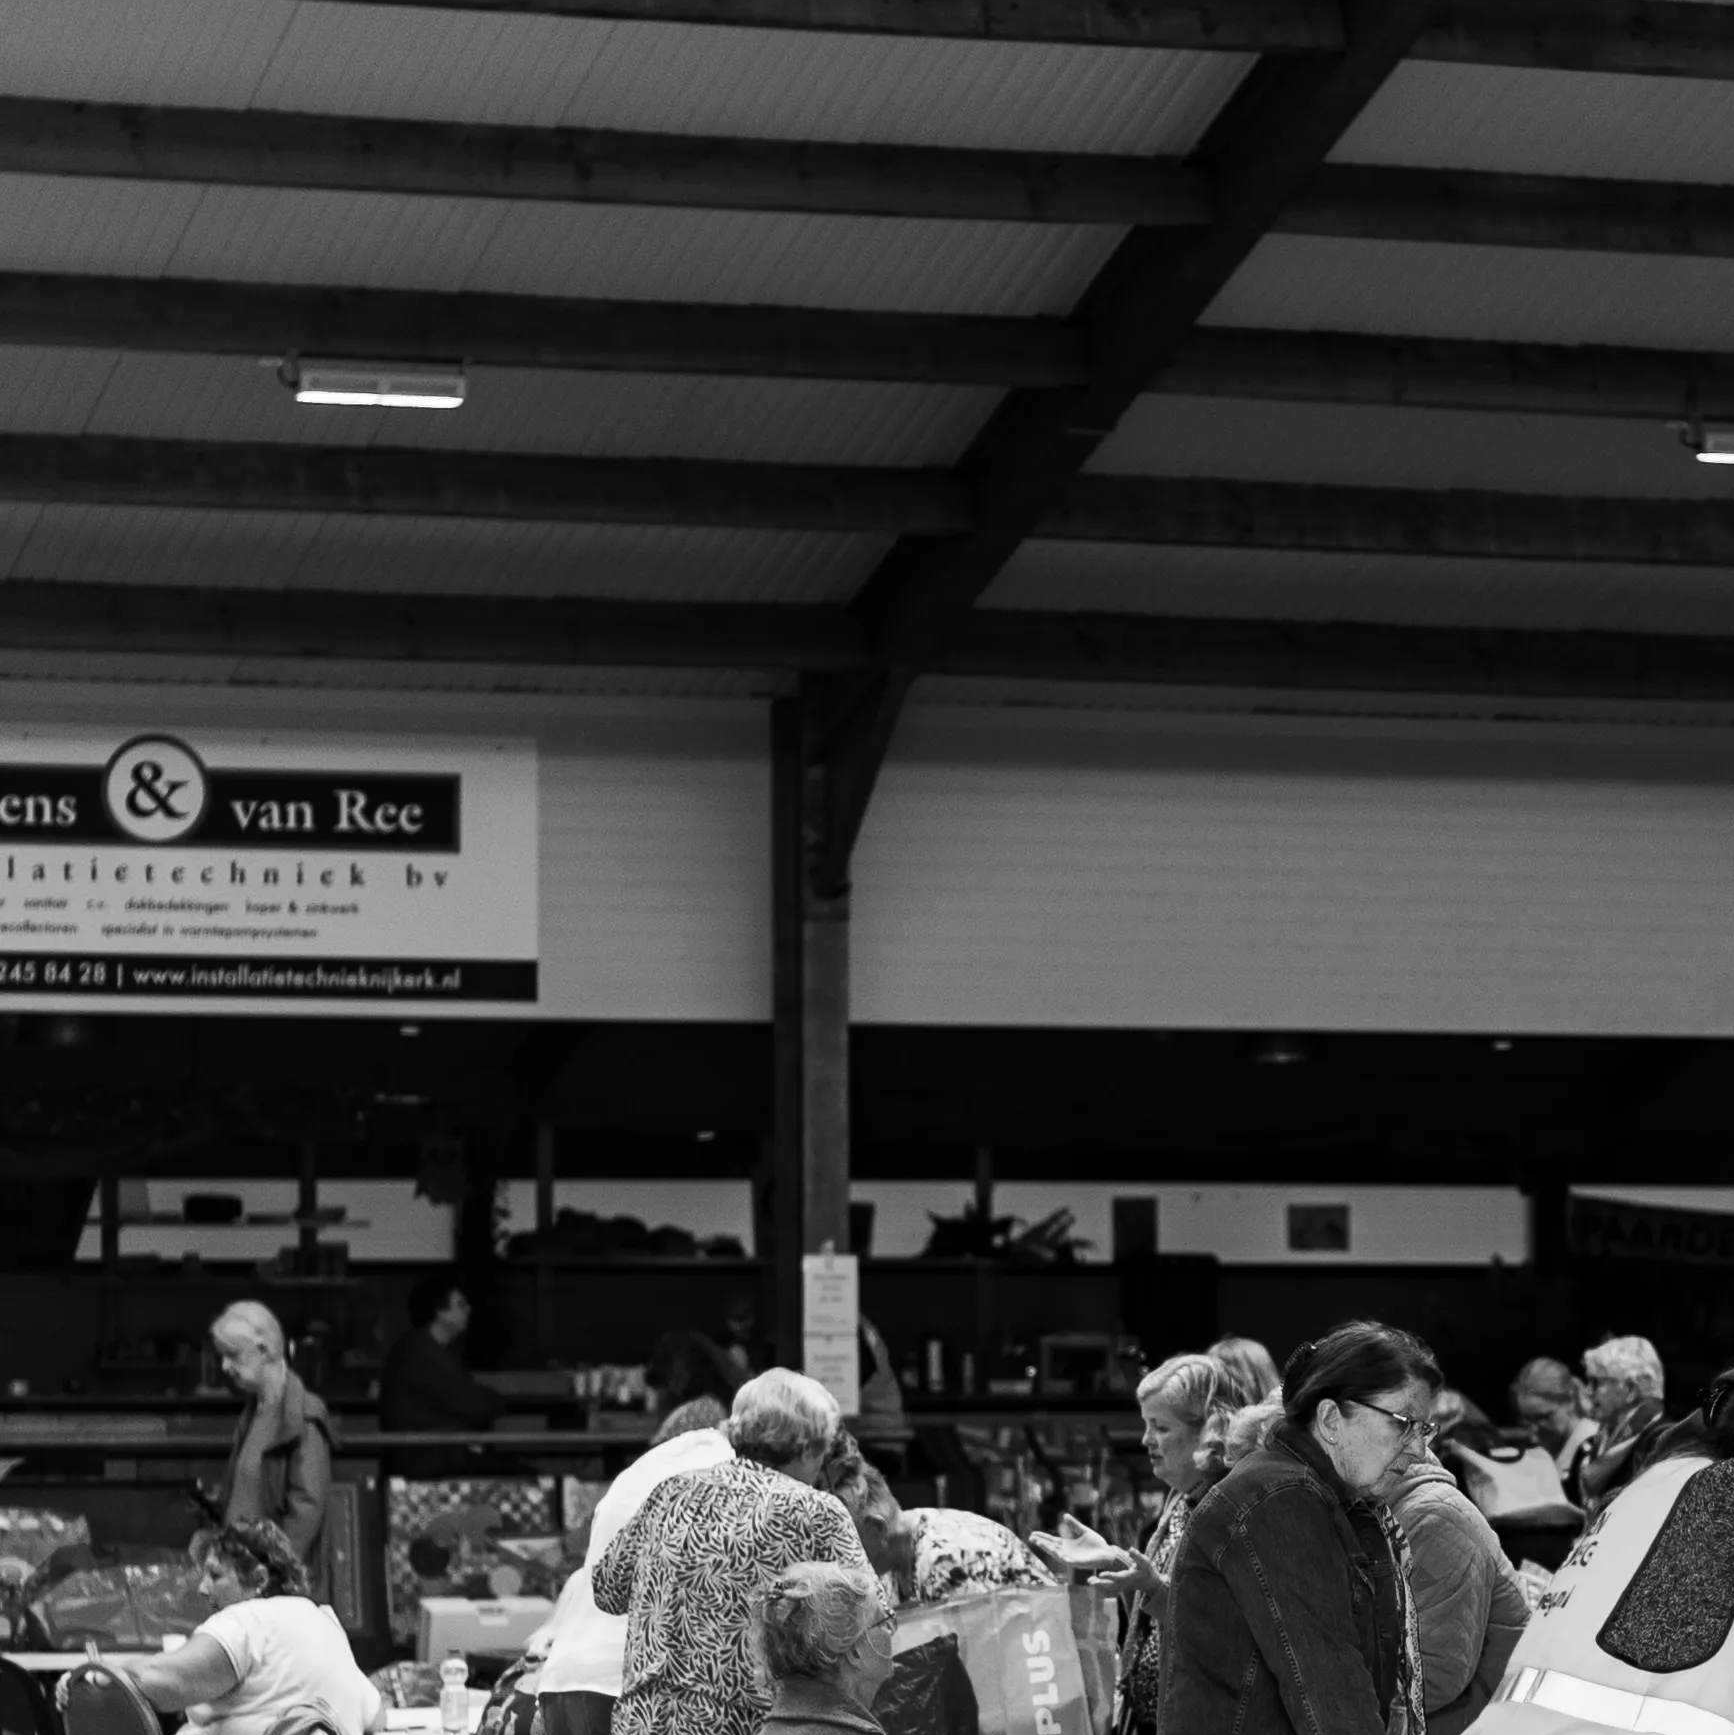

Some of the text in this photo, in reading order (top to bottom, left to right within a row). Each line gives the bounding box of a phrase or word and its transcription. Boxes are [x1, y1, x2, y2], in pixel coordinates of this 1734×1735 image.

[0, 759, 425, 835] ens & van Ree
[8, 855, 448, 889] latietechniek bv
